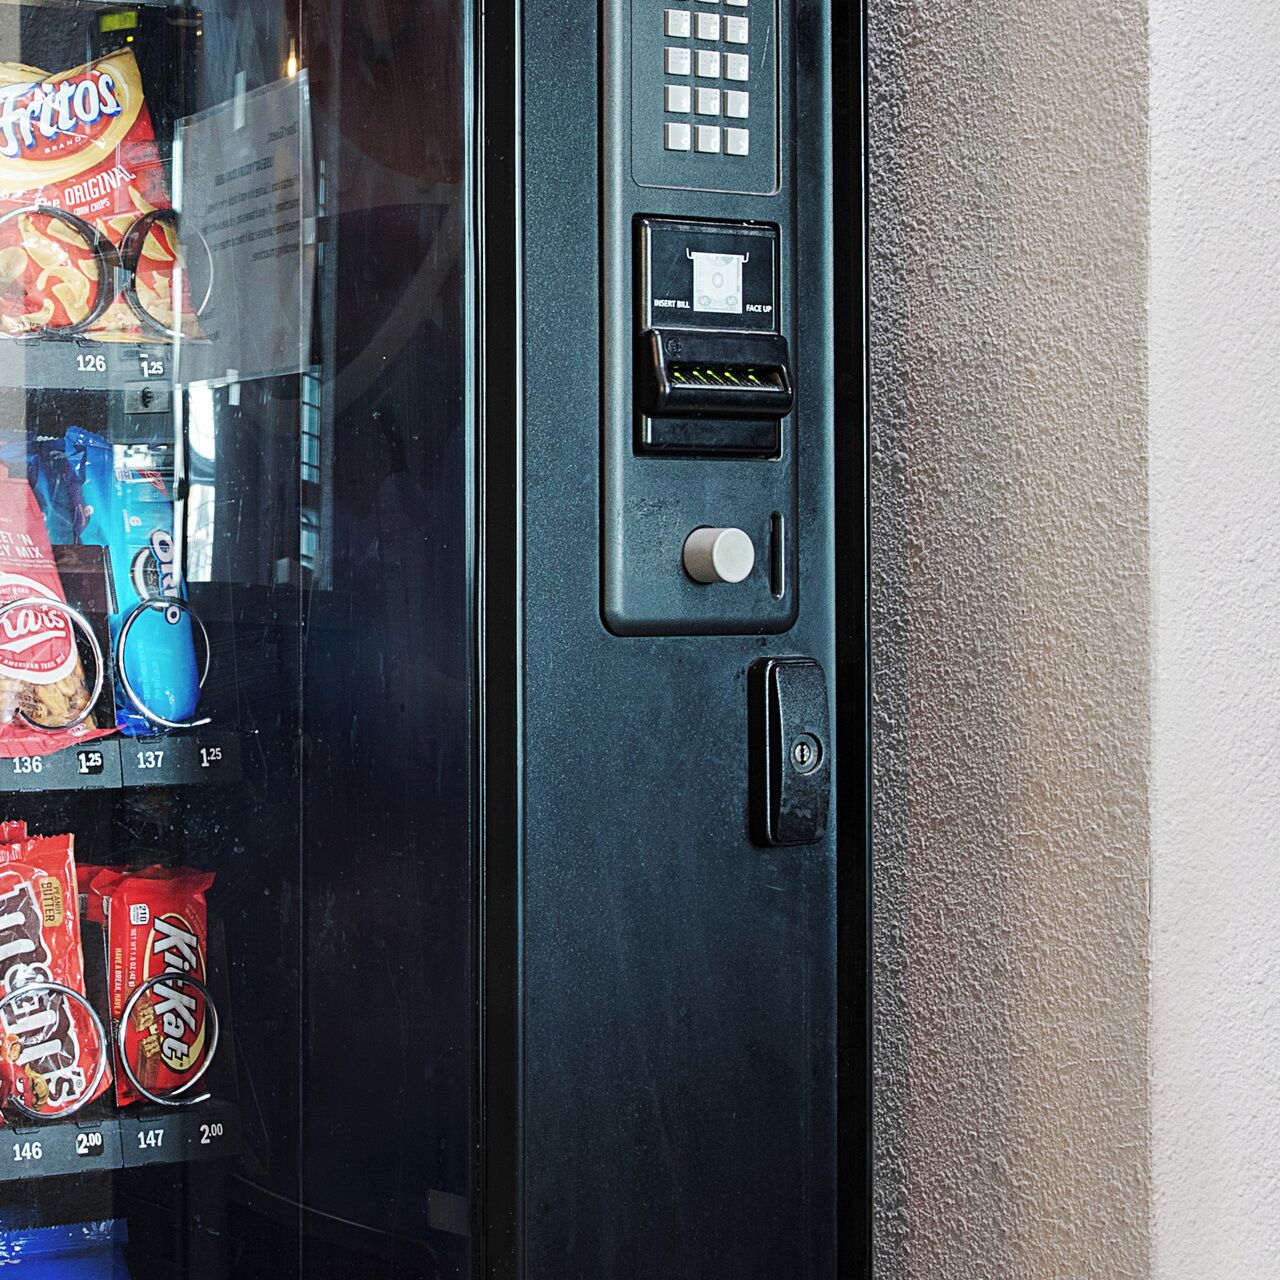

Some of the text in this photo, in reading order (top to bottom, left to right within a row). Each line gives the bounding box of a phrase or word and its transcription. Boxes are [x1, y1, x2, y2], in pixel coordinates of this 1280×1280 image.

[45, 136, 81, 154] BRAND
[64, 165, 136, 205] ORIGINAL
[654, 299, 676, 308] INSERT
[746, 304, 761, 312] FACE
[76, 354, 106, 372] 126
[16, 545, 43, 558] MIX
[13, 757, 42, 773] 136
[137, 752, 164, 768] 137
[41, 882, 55, 924] BUTTER
[138, 1130, 163, 1148] 147
[13, 1142, 42, 1161] 146
